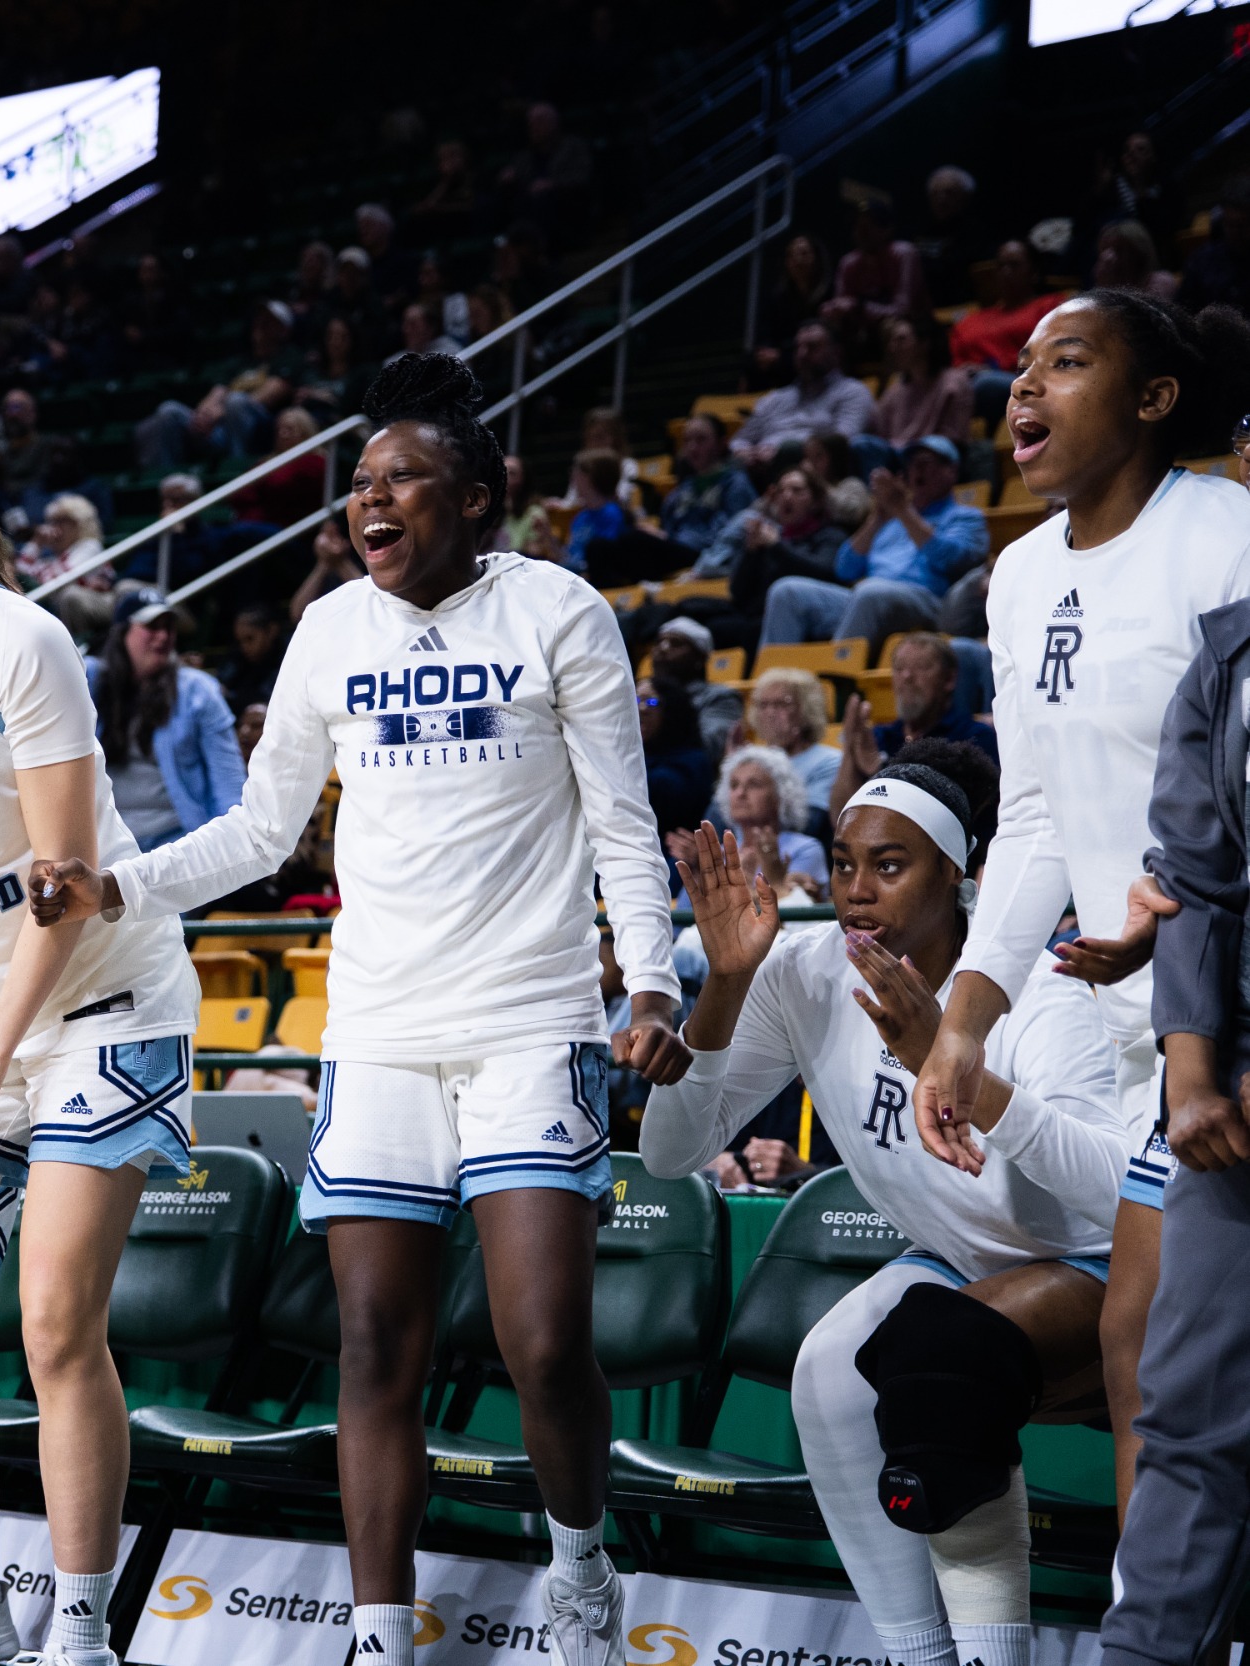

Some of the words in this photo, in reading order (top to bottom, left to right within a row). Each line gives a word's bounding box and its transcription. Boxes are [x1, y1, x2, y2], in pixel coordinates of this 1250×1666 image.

[1052, 607, 1084, 618] adidas
[346, 663, 525, 715] RHODY
[361, 742, 523, 768] BASKETBALL
[61, 1106, 93, 1116] adidas
[541, 1132, 574, 1144] adidas
[1149, 1143, 1173, 1156] adida
[140, 1191, 188, 1205] GEORGE
[188, 1191, 231, 1204] MASON
[144, 1206, 217, 1215] BASKETBALL
[821, 1211, 888, 1228] GEORGE
[832, 1228, 905, 1240] BASKETB
[183, 1438, 233, 1455] PATRIOTS
[434, 1457, 494, 1476] PATRIOTS
[675, 1475, 736, 1496] PATRIOTS
[224, 1587, 354, 1626] Sentara
[460, 1613, 551, 1654] Sent
